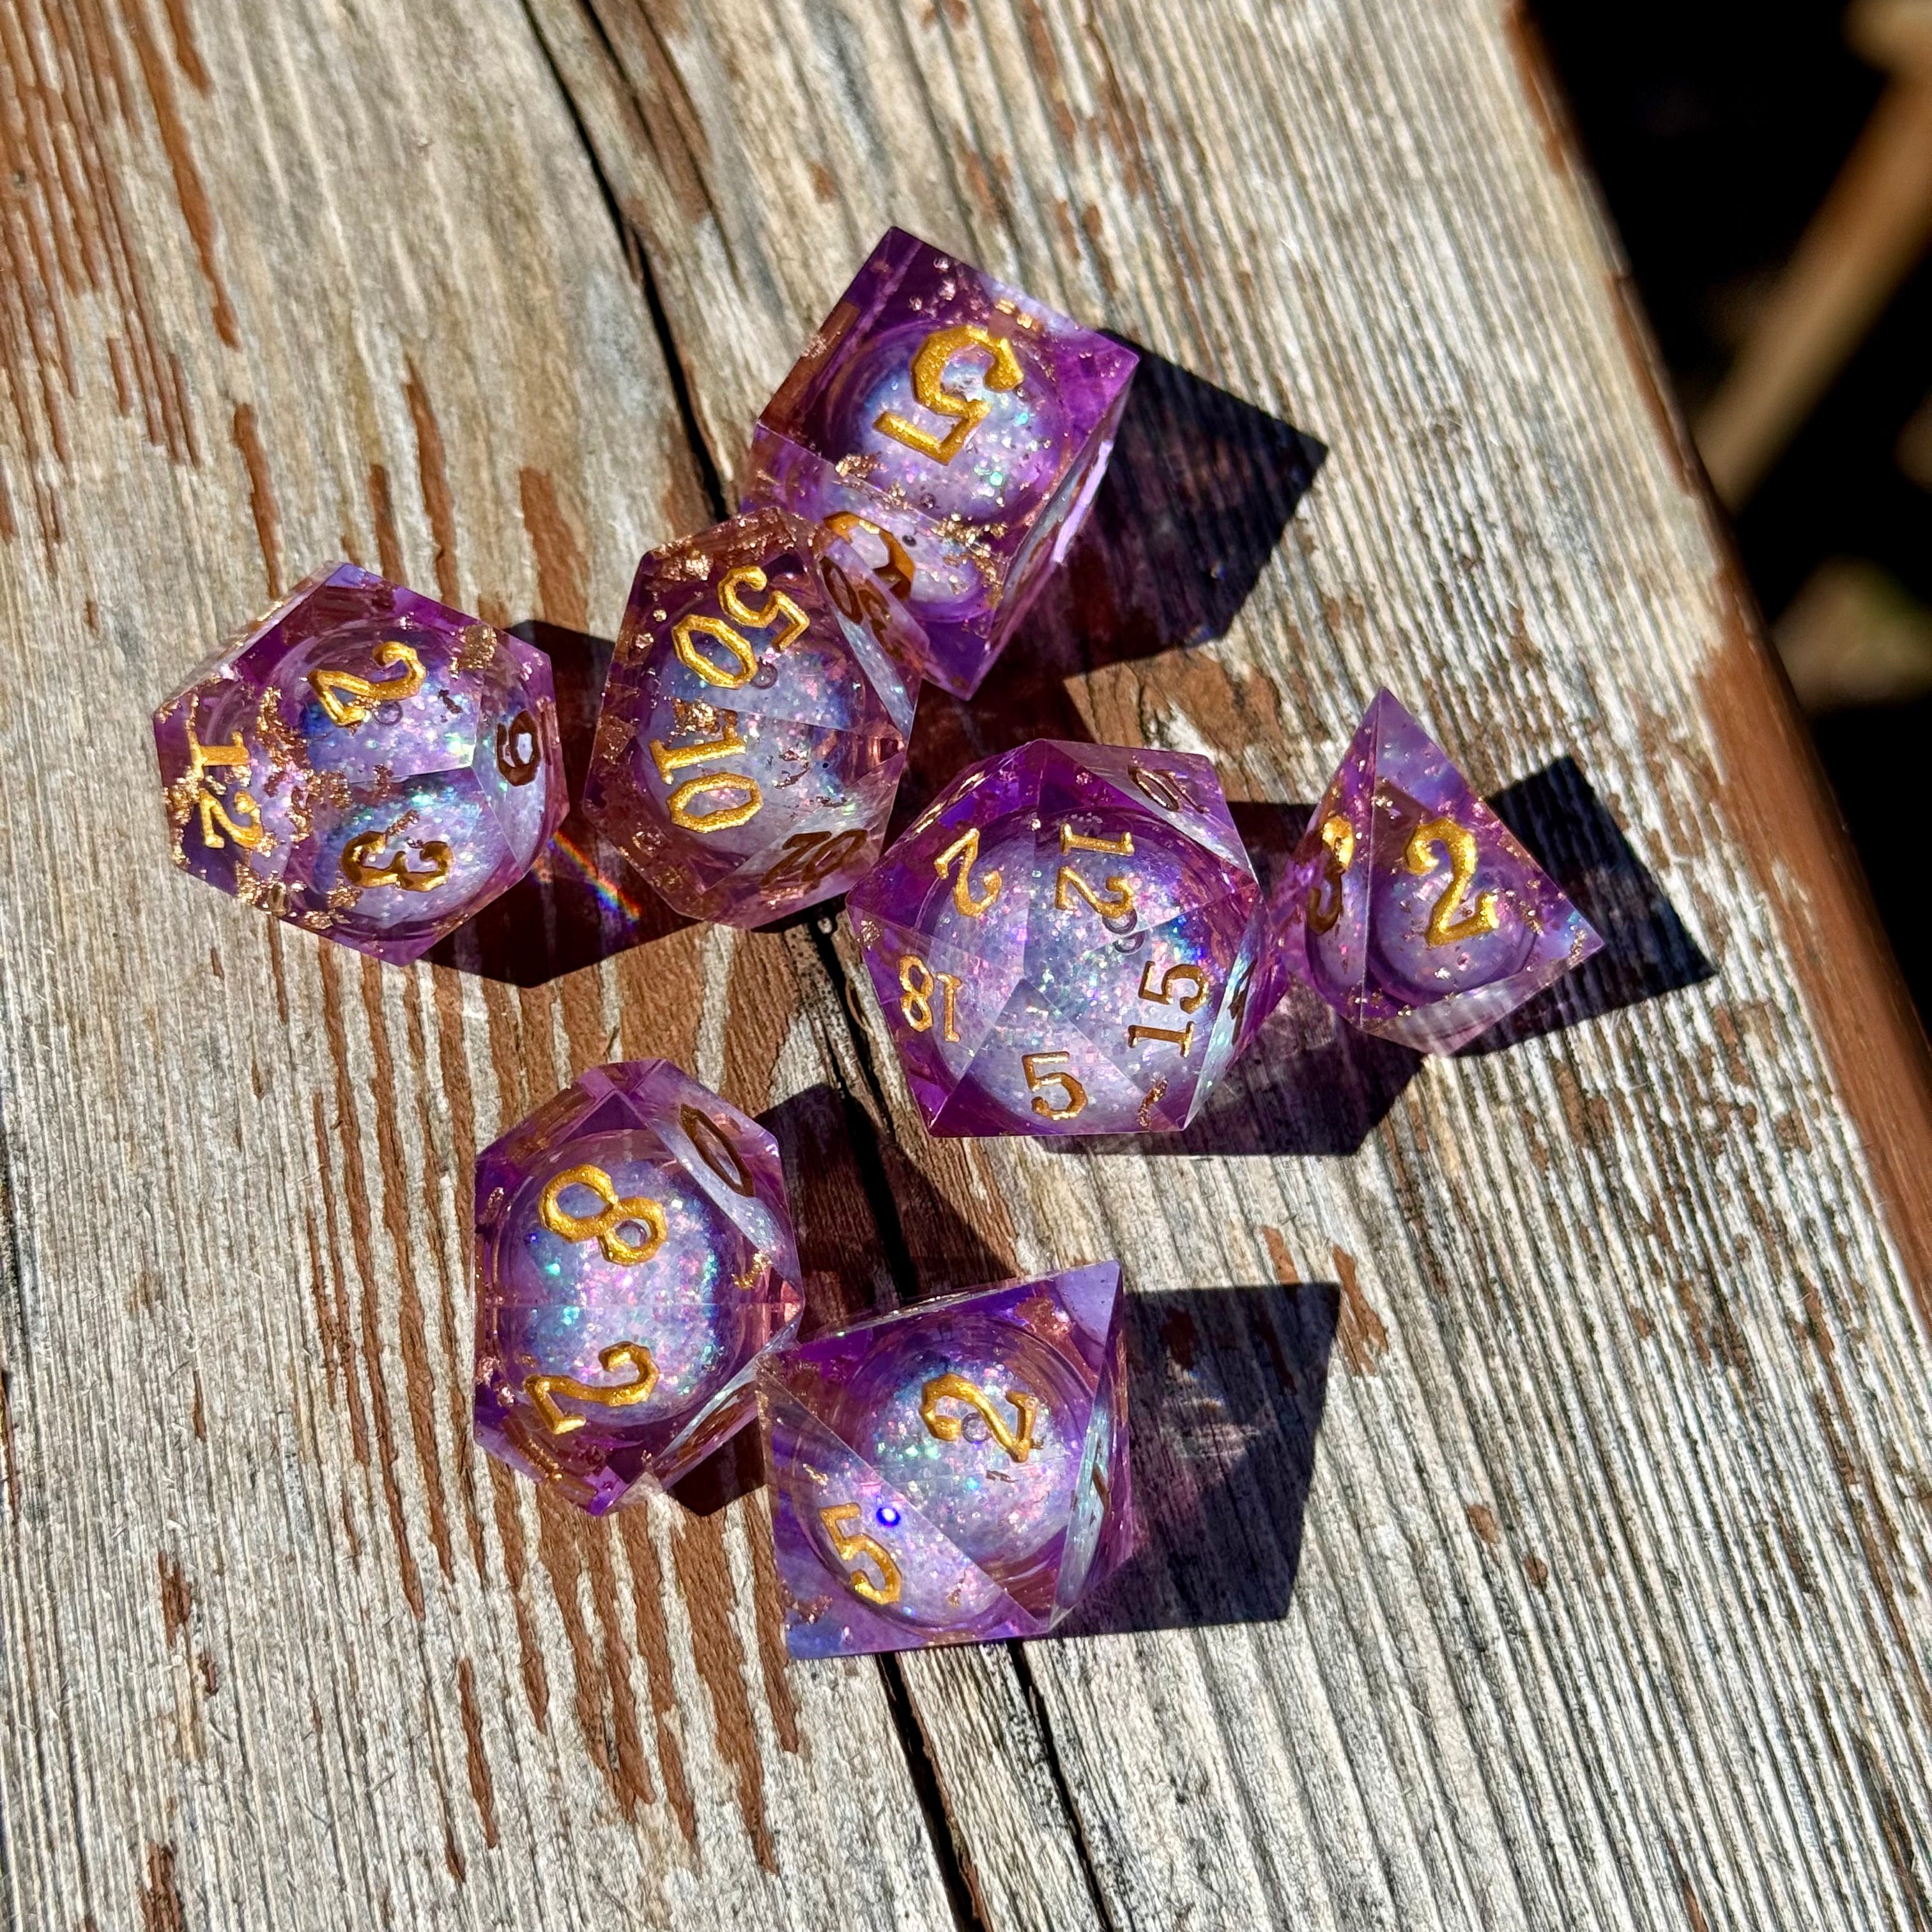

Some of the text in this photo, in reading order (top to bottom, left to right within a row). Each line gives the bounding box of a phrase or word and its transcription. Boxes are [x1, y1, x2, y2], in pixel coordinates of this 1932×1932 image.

[873, 325, 1023, 466] 5
[671, 566, 809, 689] 50
[309, 641, 427, 726] 2
[188, 727, 264, 848] 12
[648, 725, 763, 833] 10
[341, 831, 454, 893] 3
[934, 828, 1002, 917] 2
[1054, 823, 1135, 918] 12
[1406, 816, 1499, 949] 2
[899, 954, 962, 1043] 18
[1128, 960, 1209, 1057] 15
[1022, 1051, 1088, 1121] 5
[539, 1164, 668, 1266] 8
[525, 1341, 660, 1435] 2
[919, 1372, 1037, 1463] 2
[819, 1502, 902, 1606] 5
